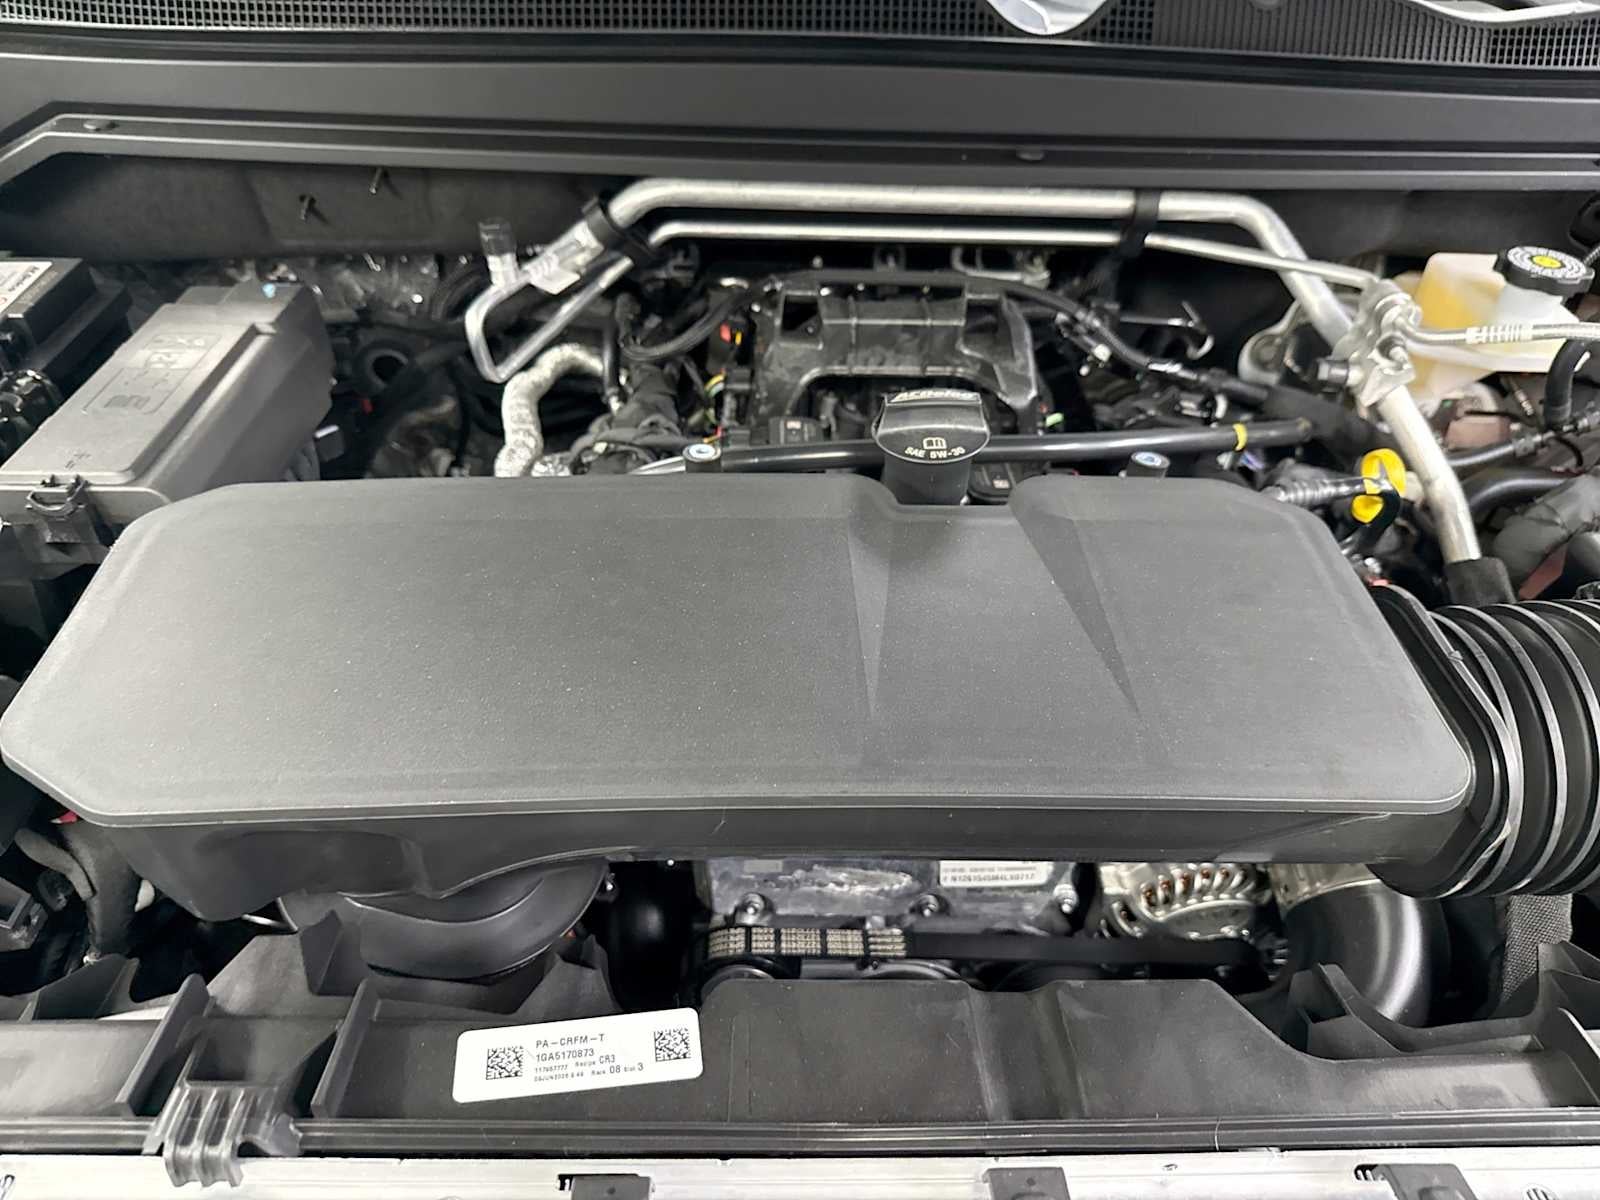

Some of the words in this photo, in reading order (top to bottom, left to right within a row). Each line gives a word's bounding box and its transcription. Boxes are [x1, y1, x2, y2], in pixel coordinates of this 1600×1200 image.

[904, 446, 926, 458] SAE
[929, 446, 966, 459] 5W-30
[599, 1054, 616, 1065] CR3
[609, 1064, 621, 1074] 08
[637, 1062, 644, 1072] 3
